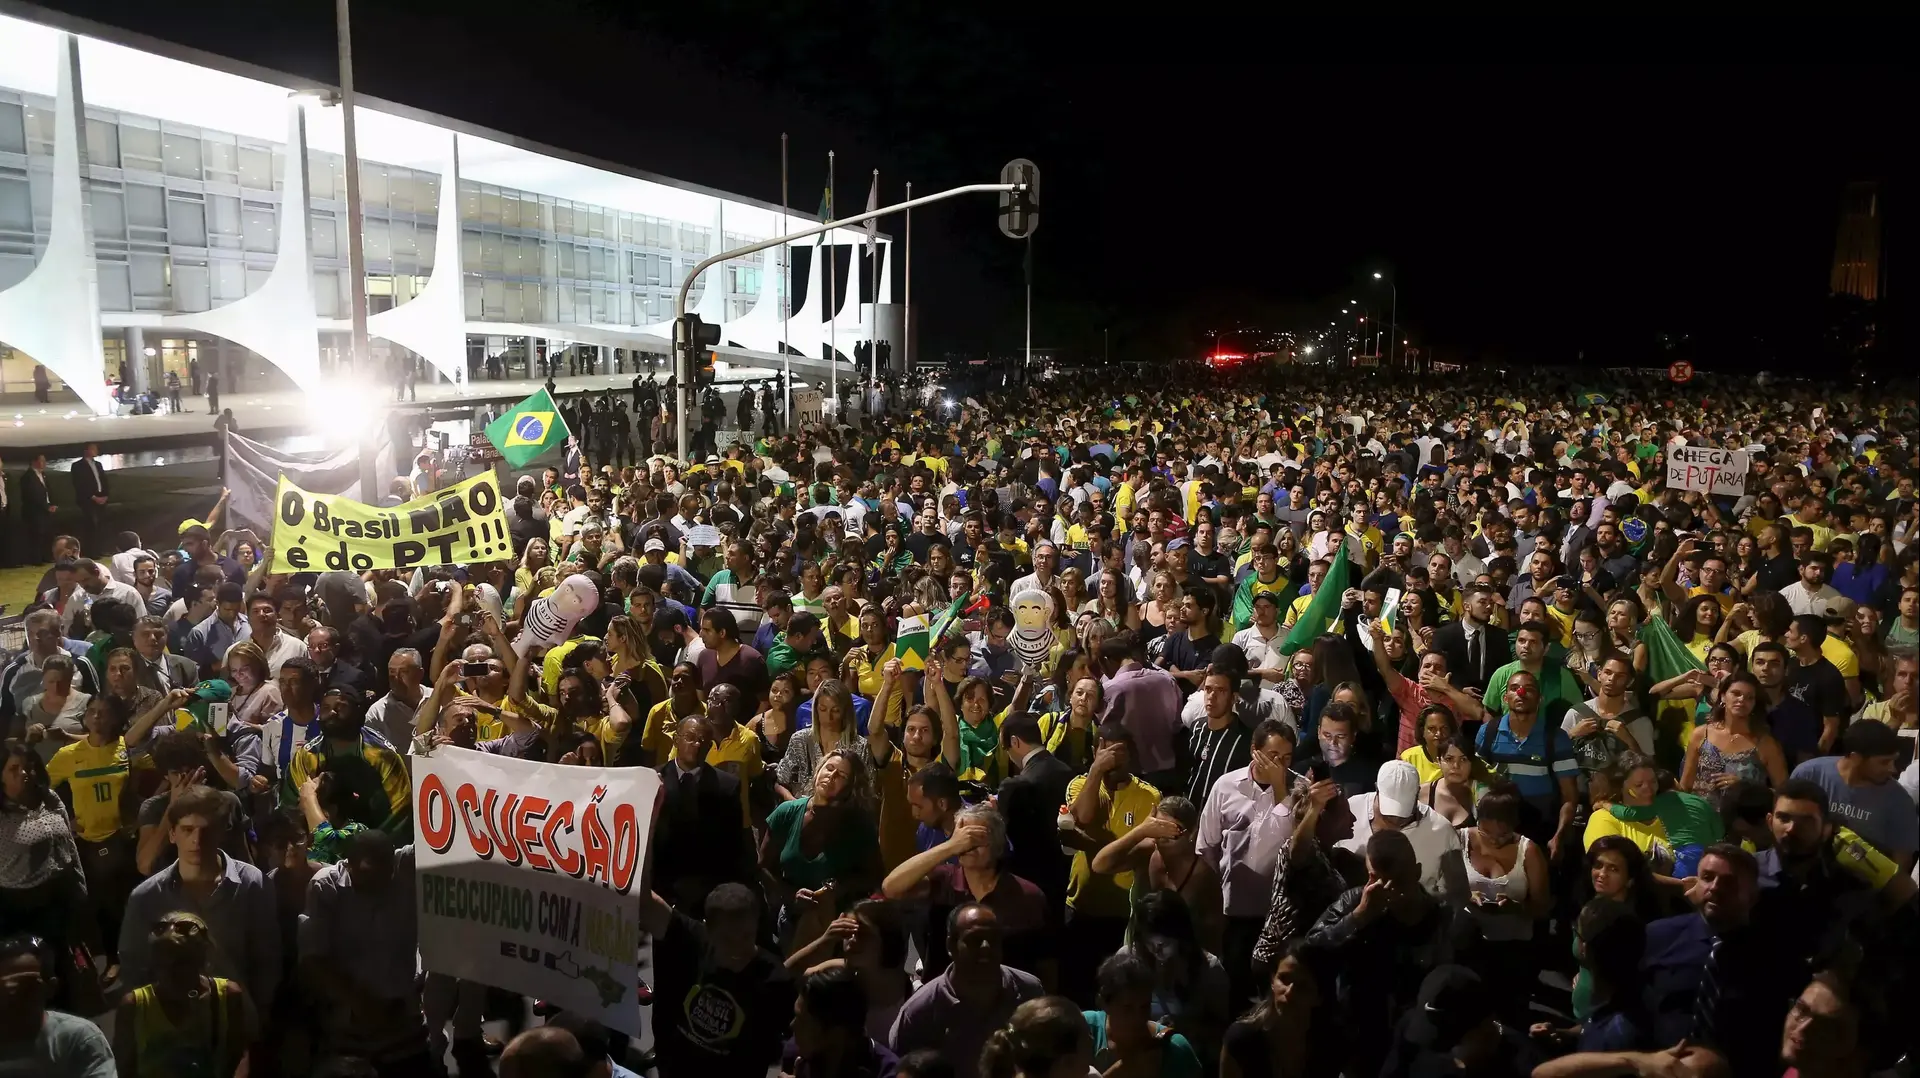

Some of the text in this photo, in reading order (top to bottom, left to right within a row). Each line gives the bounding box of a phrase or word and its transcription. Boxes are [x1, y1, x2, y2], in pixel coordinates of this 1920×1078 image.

[1673, 447, 1735, 467] CHEGA
[281, 481, 496, 539] O Brasil NÃO
[286, 535, 310, 569] é
[325, 541, 373, 571] do
[92, 782, 113, 803] 10
[419, 773, 456, 855] O
[422, 873, 533, 933] PREOCUPADO
[538, 891, 571, 942] COM
[570, 902, 581, 947] A
